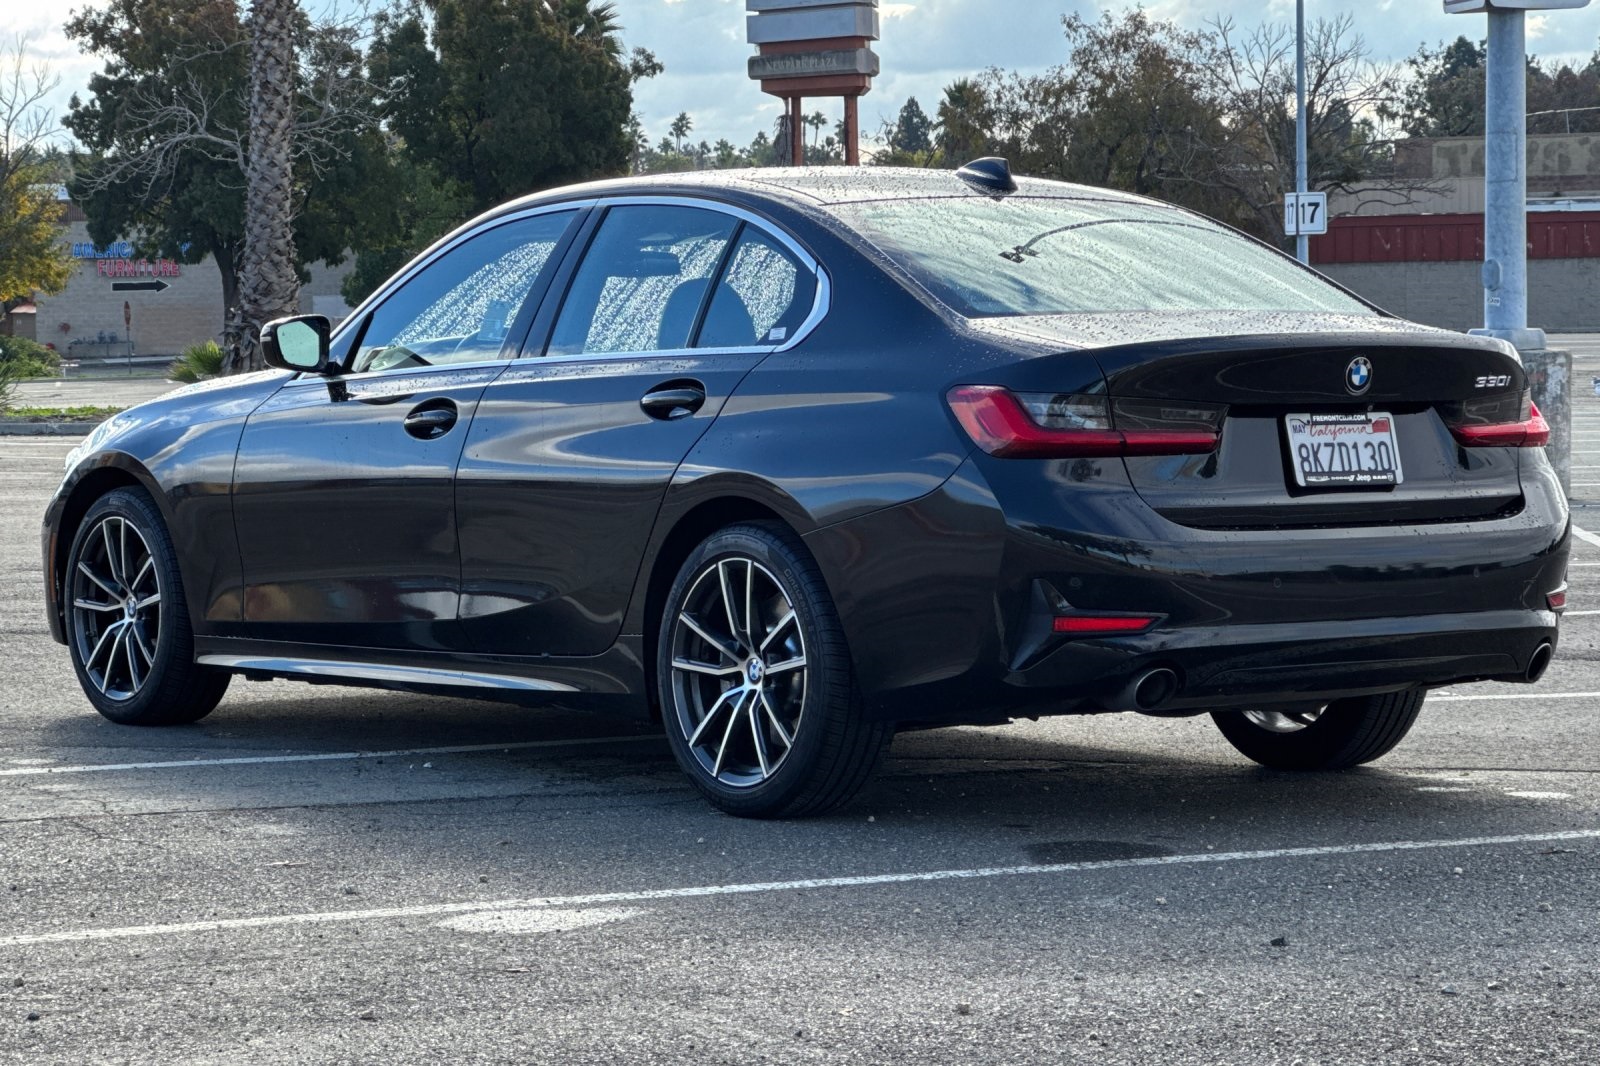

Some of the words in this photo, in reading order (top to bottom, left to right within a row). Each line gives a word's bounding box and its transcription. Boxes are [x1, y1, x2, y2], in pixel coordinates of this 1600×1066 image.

[1300, 201, 1321, 225] 17
[96, 259, 180, 277] FURNITURE
[1292, 424, 1306, 433] MAY
[1310, 424, 1368, 441] California
[1298, 441, 1392, 472] 8KZD130
[1356, 473, 1371, 482] Jeep
